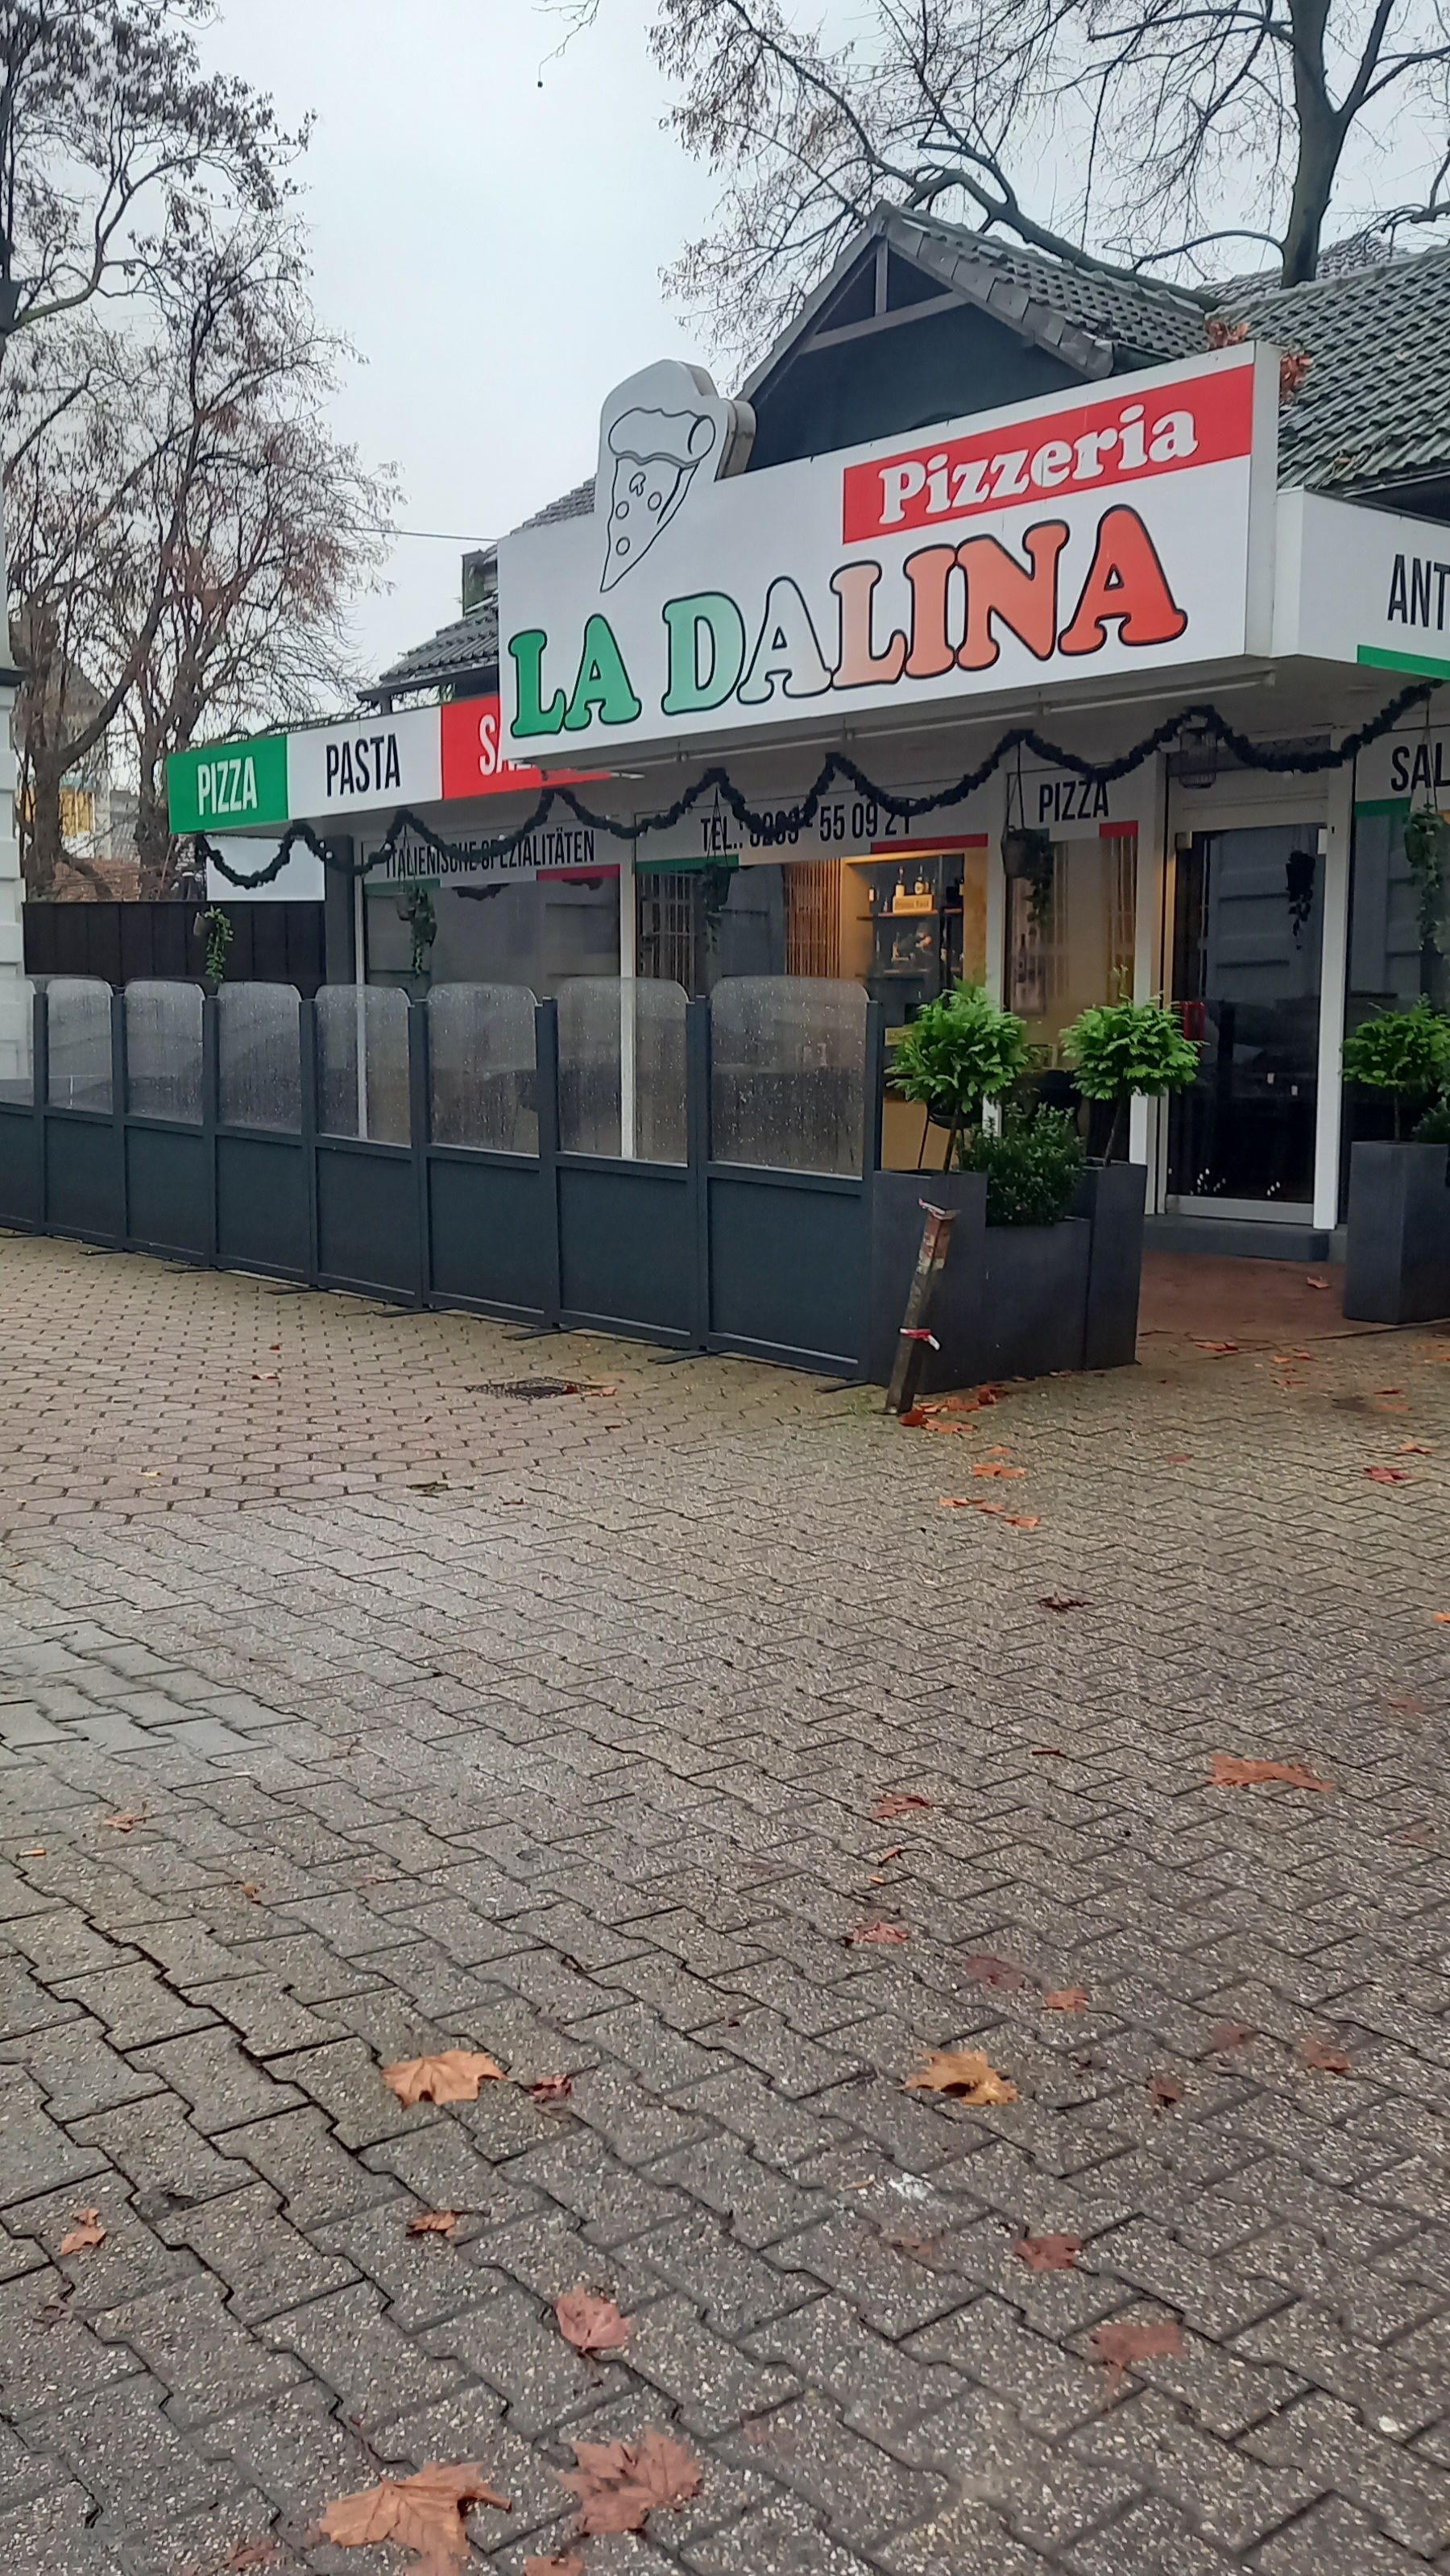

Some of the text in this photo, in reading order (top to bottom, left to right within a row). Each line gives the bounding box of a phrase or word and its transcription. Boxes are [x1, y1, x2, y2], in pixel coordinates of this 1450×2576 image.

[879, 404, 1199, 524] Pizzeria
[509, 504, 1188, 738] LA DALINA
[197, 733, 401, 816] PIZZA PASTA
[1039, 779, 1109, 822] PIZZA
[819, 805, 845, 842] 55
[851, 802, 879, 839] 09
